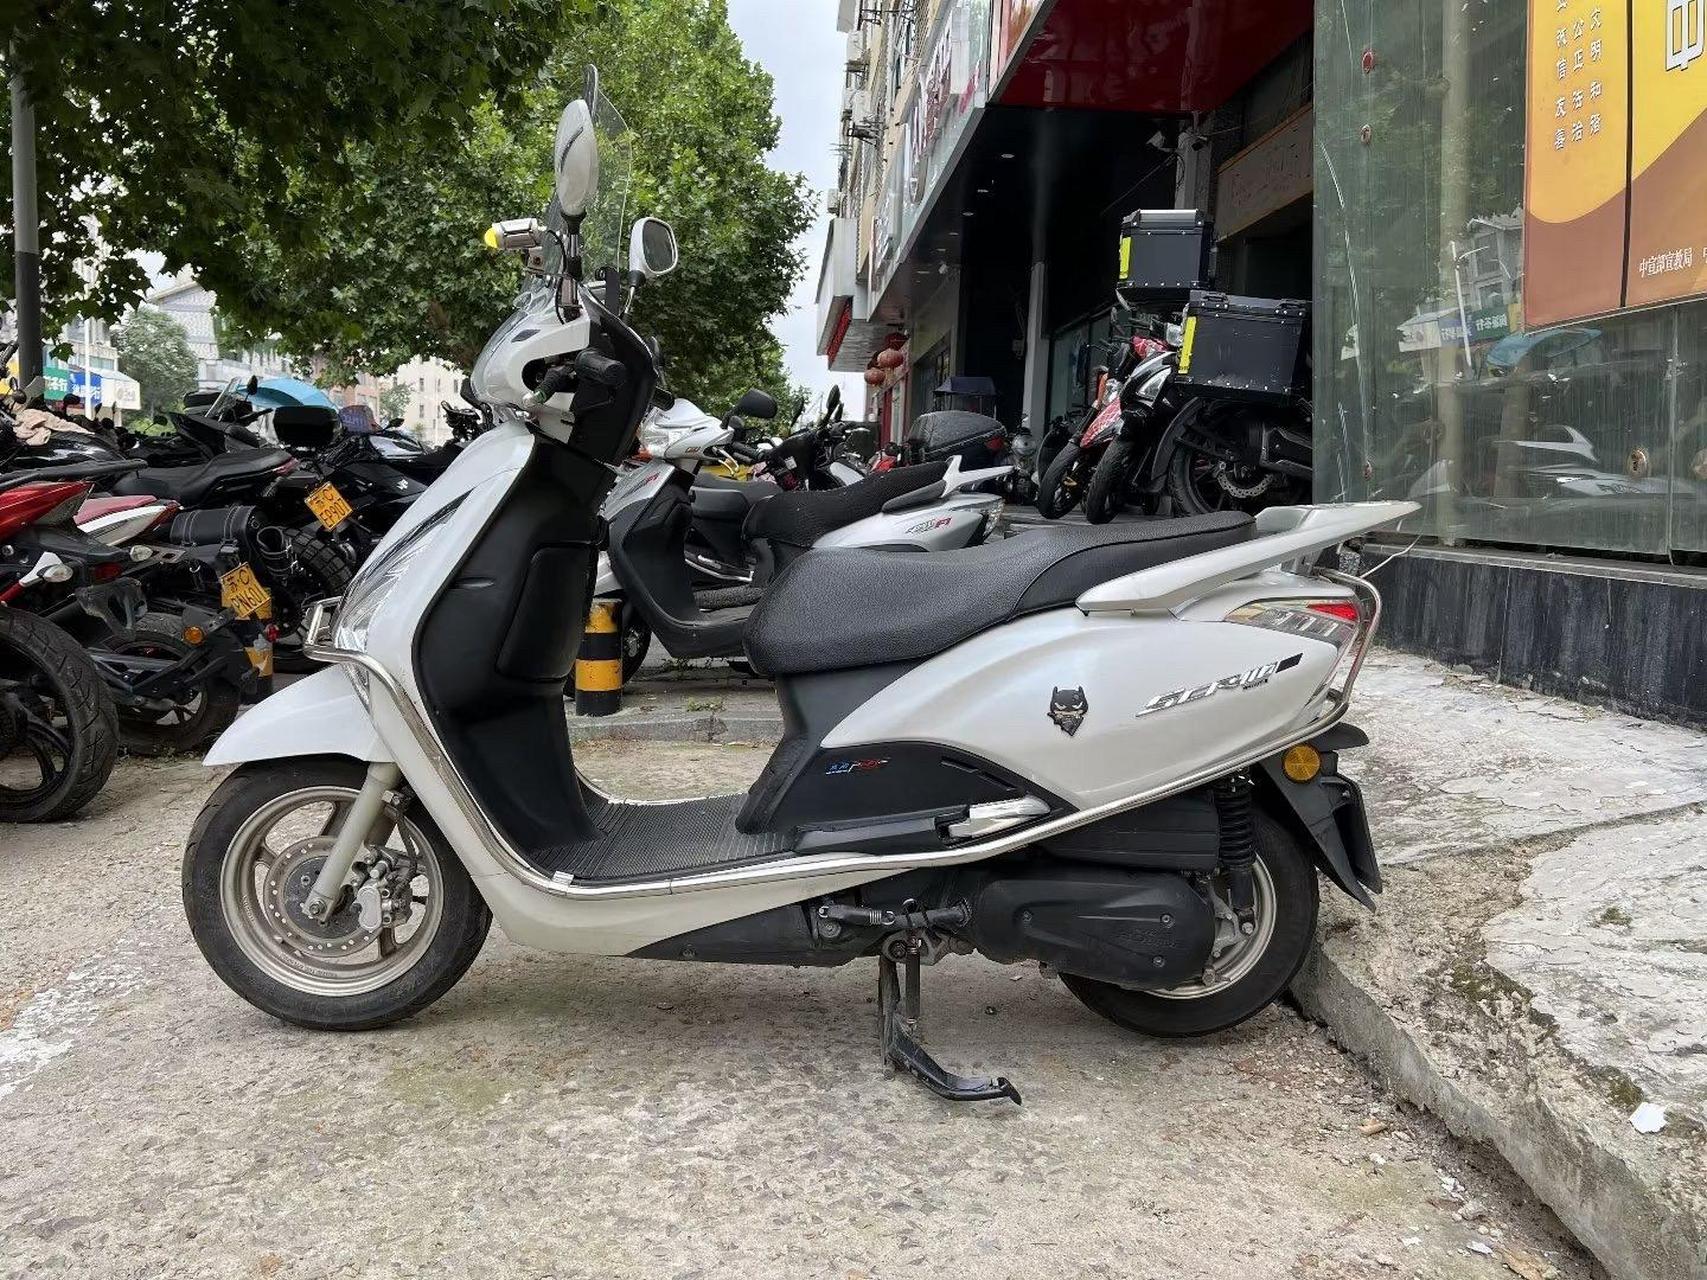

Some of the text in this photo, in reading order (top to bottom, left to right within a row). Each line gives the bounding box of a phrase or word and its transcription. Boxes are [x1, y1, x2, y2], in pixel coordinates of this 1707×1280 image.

[1639, 248, 1692, 278] 中宣部宣教局
